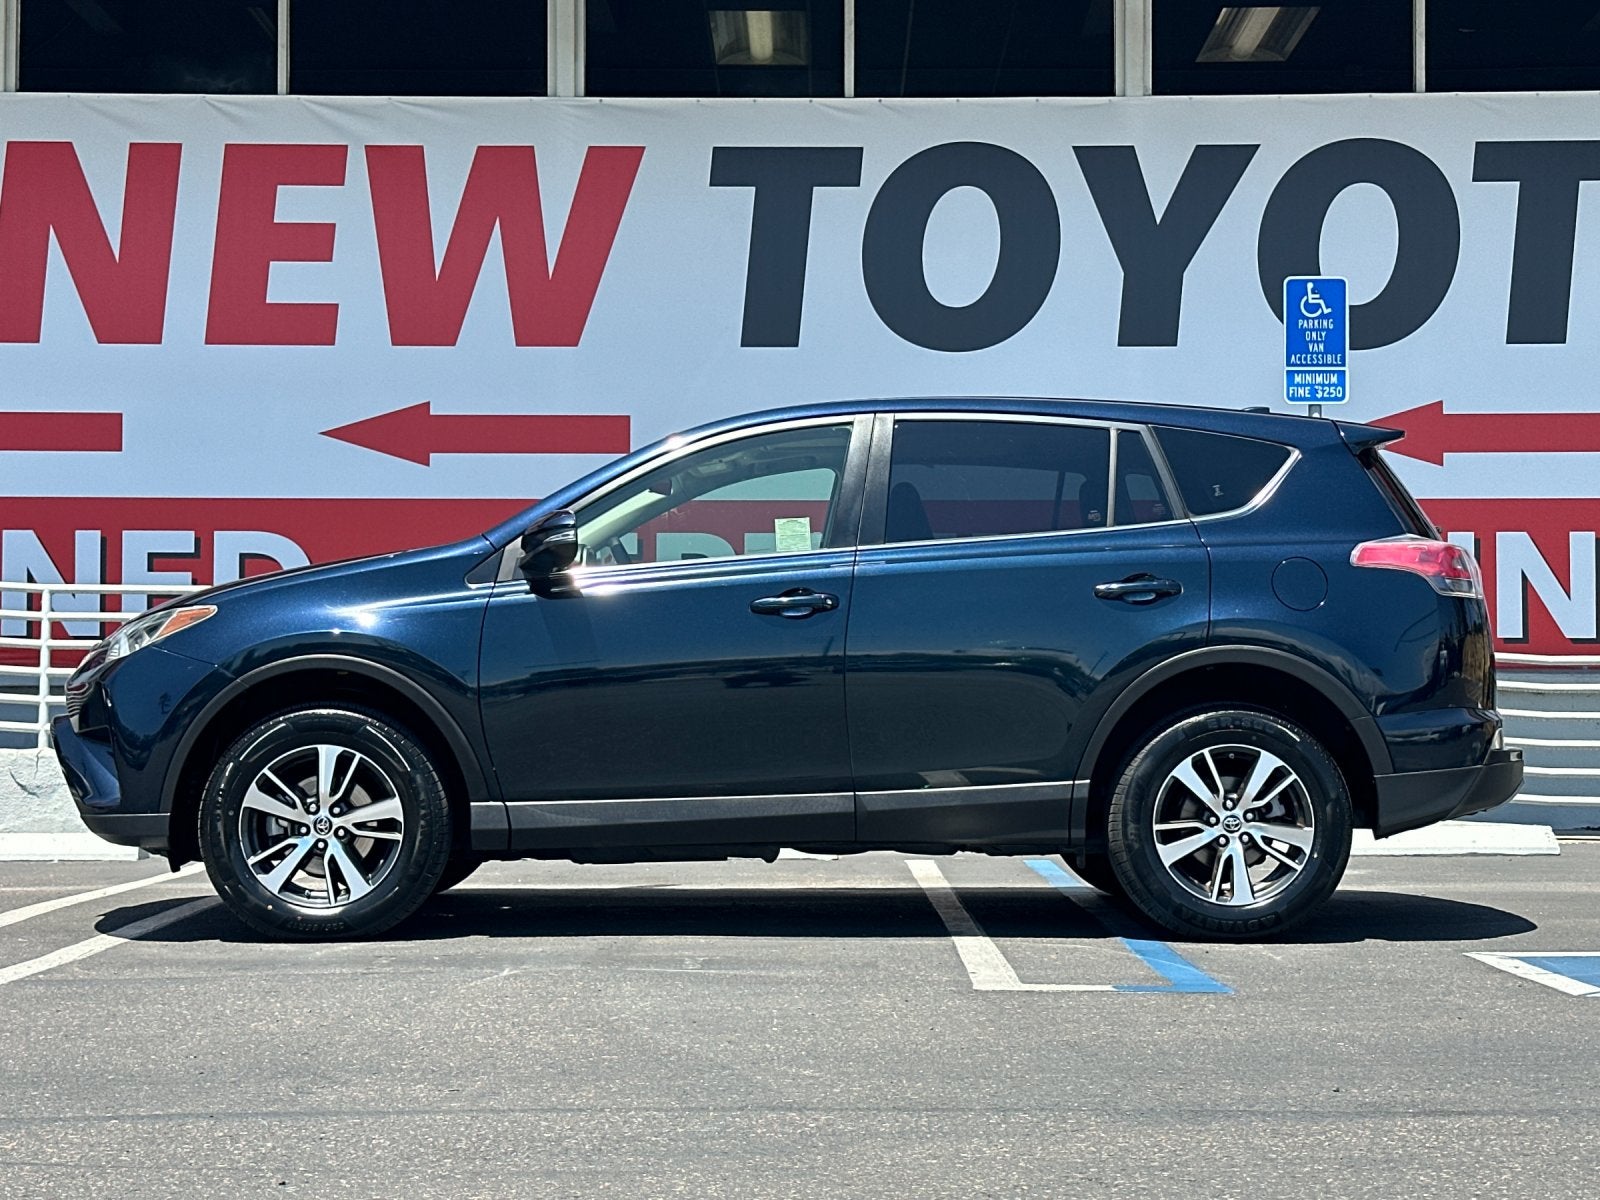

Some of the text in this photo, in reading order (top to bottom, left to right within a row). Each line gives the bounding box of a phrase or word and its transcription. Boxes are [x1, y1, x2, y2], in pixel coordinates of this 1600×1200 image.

[0, 138, 1600, 352] NEW TOYOT
[1298, 319, 1334, 329] PARKING
[1305, 331, 1327, 341] ONLY
[1308, 343, 1324, 352] VAN
[1290, 354, 1342, 364] ACCESSIBLE
[1294, 373, 1338, 384] MINIMUM
[1289, 386, 1343, 398] FINE $250
